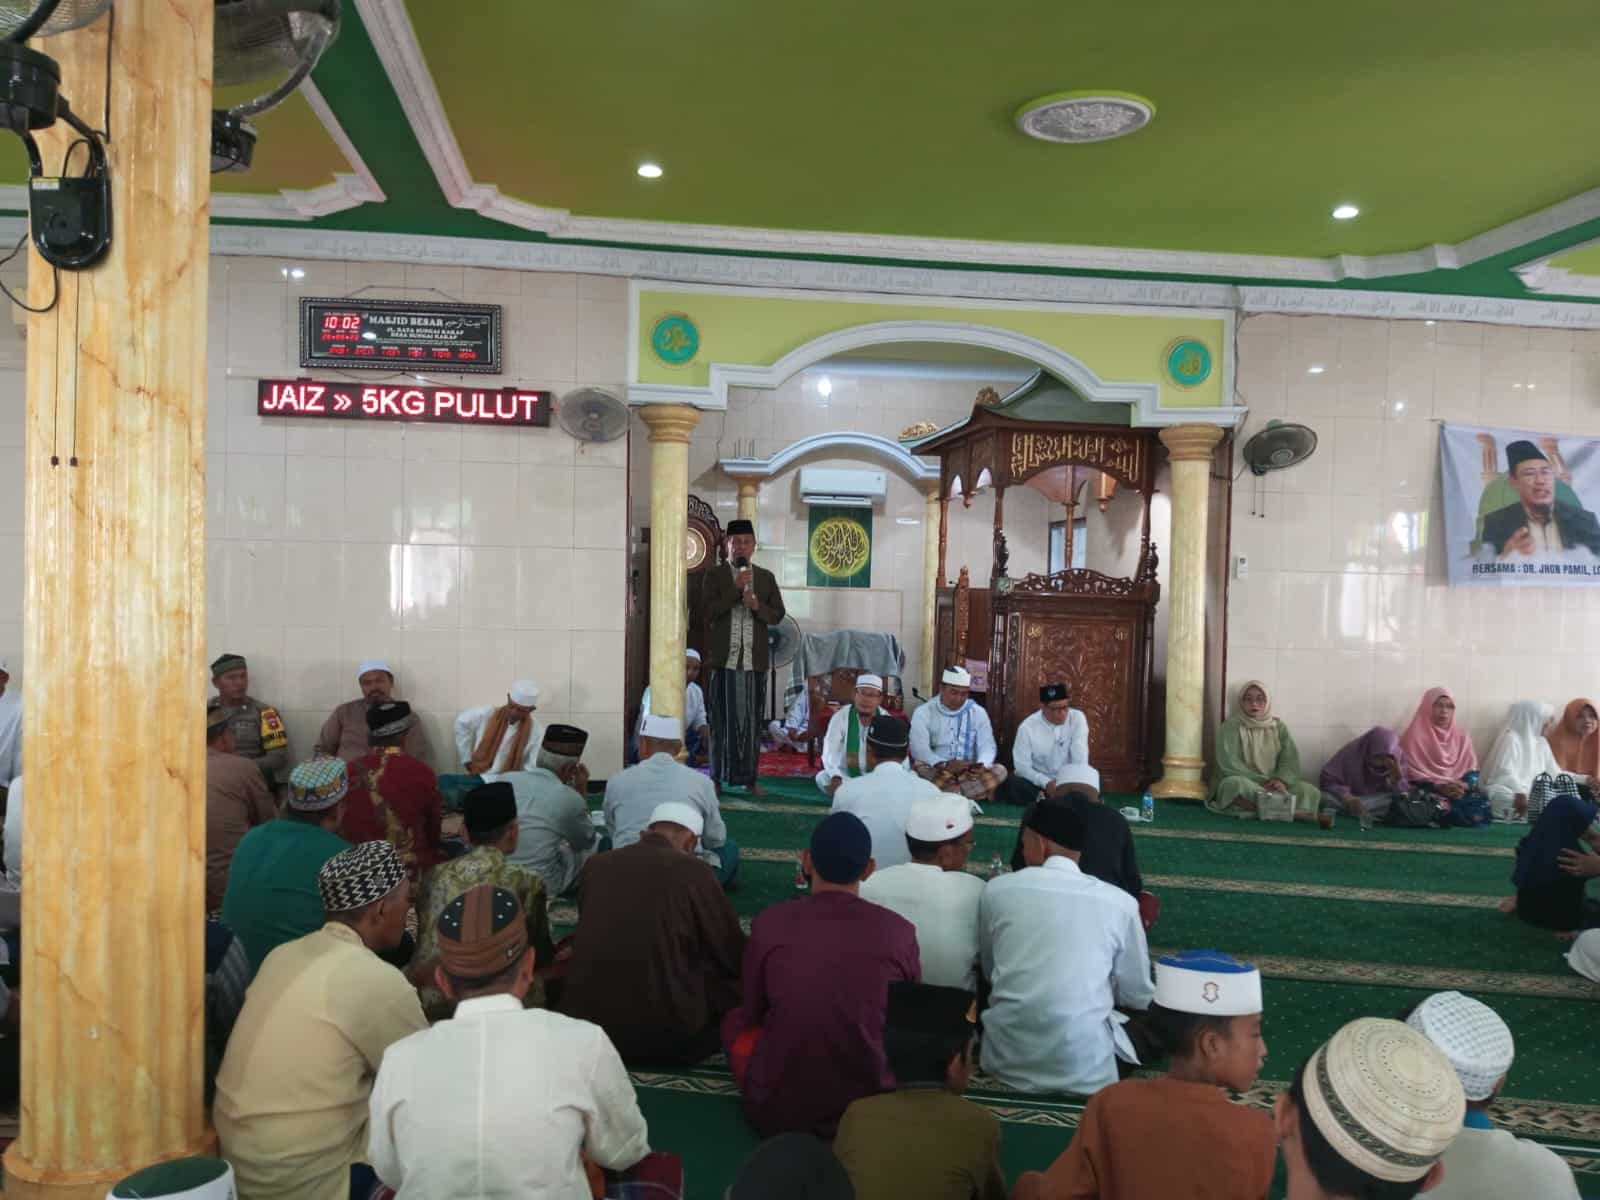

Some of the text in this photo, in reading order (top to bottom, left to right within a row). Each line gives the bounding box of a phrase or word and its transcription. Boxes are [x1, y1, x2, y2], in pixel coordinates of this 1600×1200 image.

[369, 315, 444, 328] MASJID BESAR
[263, 385, 325, 411] JAIZ
[361, 389, 426, 415] 5KG
[434, 391, 539, 420] PULUT
[1472, 563, 1516, 574] BERSAMA
